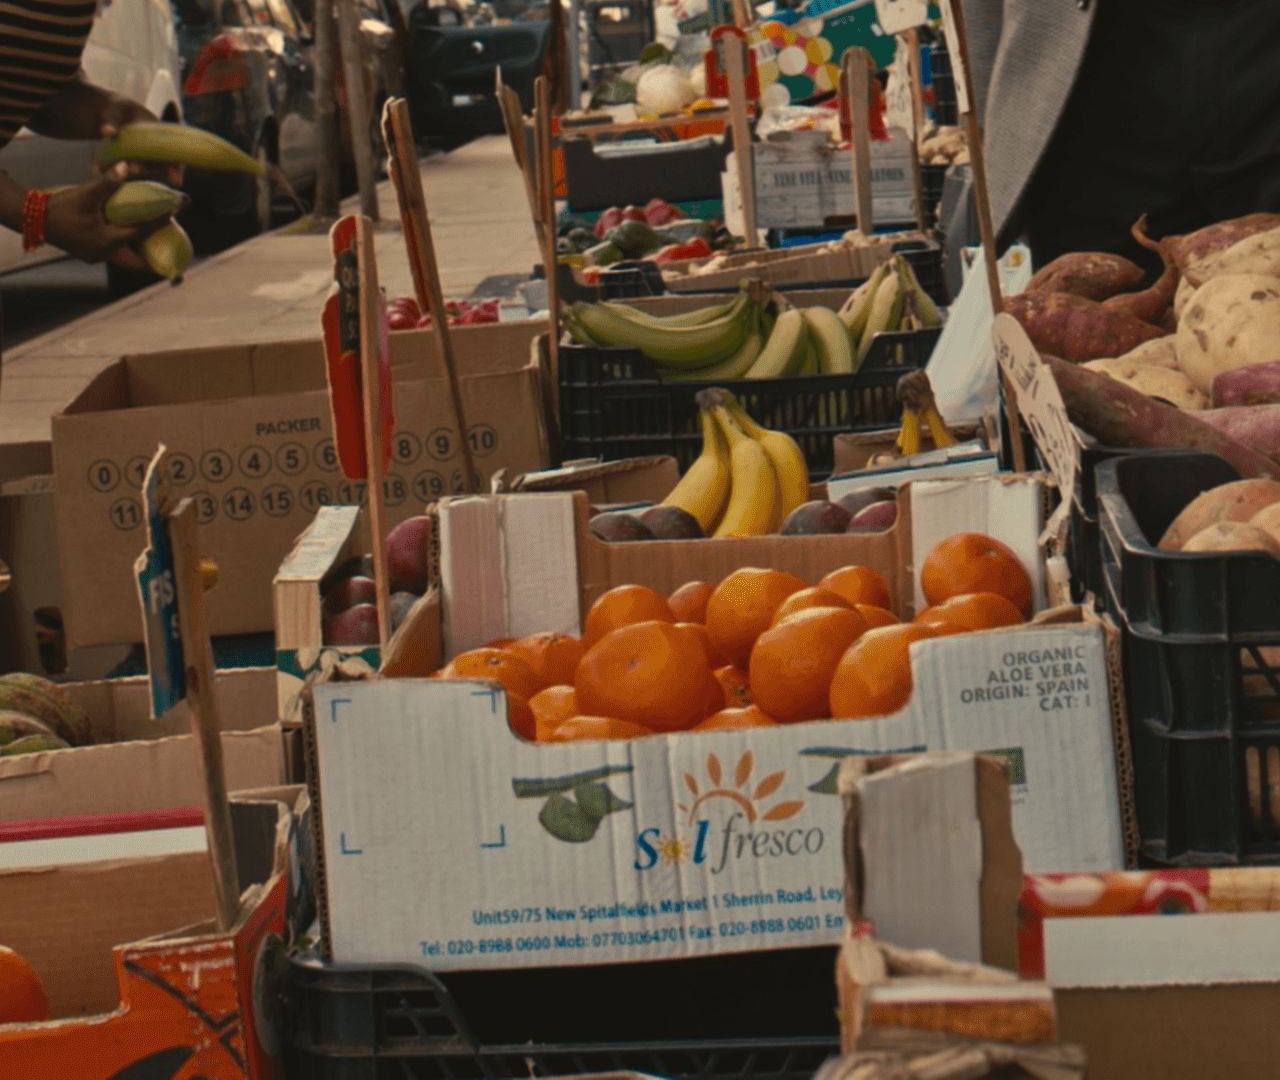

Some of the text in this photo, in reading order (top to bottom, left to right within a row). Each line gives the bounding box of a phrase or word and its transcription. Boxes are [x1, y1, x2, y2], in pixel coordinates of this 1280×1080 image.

[255, 418, 321, 436] PACKER
[98, 466, 111, 486] 0
[171, 459, 186, 480] 2
[209, 456, 223, 476] 3
[247, 452, 261, 472] 4
[285, 449, 299, 468] 5
[323, 446, 336, 466] 6
[398, 439, 412, 459] 8
[435, 435, 449, 455] 9
[115, 505, 137, 524] 11
[226, 494, 253, 514] 14
[263, 491, 291, 511] 15
[304, 487, 329, 507] 16
[342, 484, 367, 503] 17
[420, 477, 443, 496] 19
[1002, 645, 1086, 667] ORGANIC
[987, 662, 1087, 685] ALOE VERA
[960, 678, 1089, 704] ORIGIN: SPAIN
[1039, 695, 1079, 712] CAT:
[710, 812, 824, 875] fresco
[472, 907, 542, 925] Unit59/75
[545, 905, 577, 921] New
[579, 898, 656, 923] Spitalfields
[659, 897, 708, 915] Market
[723, 891, 774, 909] Sherrin
[776, 886, 817, 904] Road,
[419, 940, 445, 956] Tel:
[447, 938, 513, 956] 020-8988
[516, 935, 551, 952] 0600
[554, 932, 589, 949] Mob:
[720, 920, 784, 938] 020-8988
[787, 915, 821, 932] 0601
